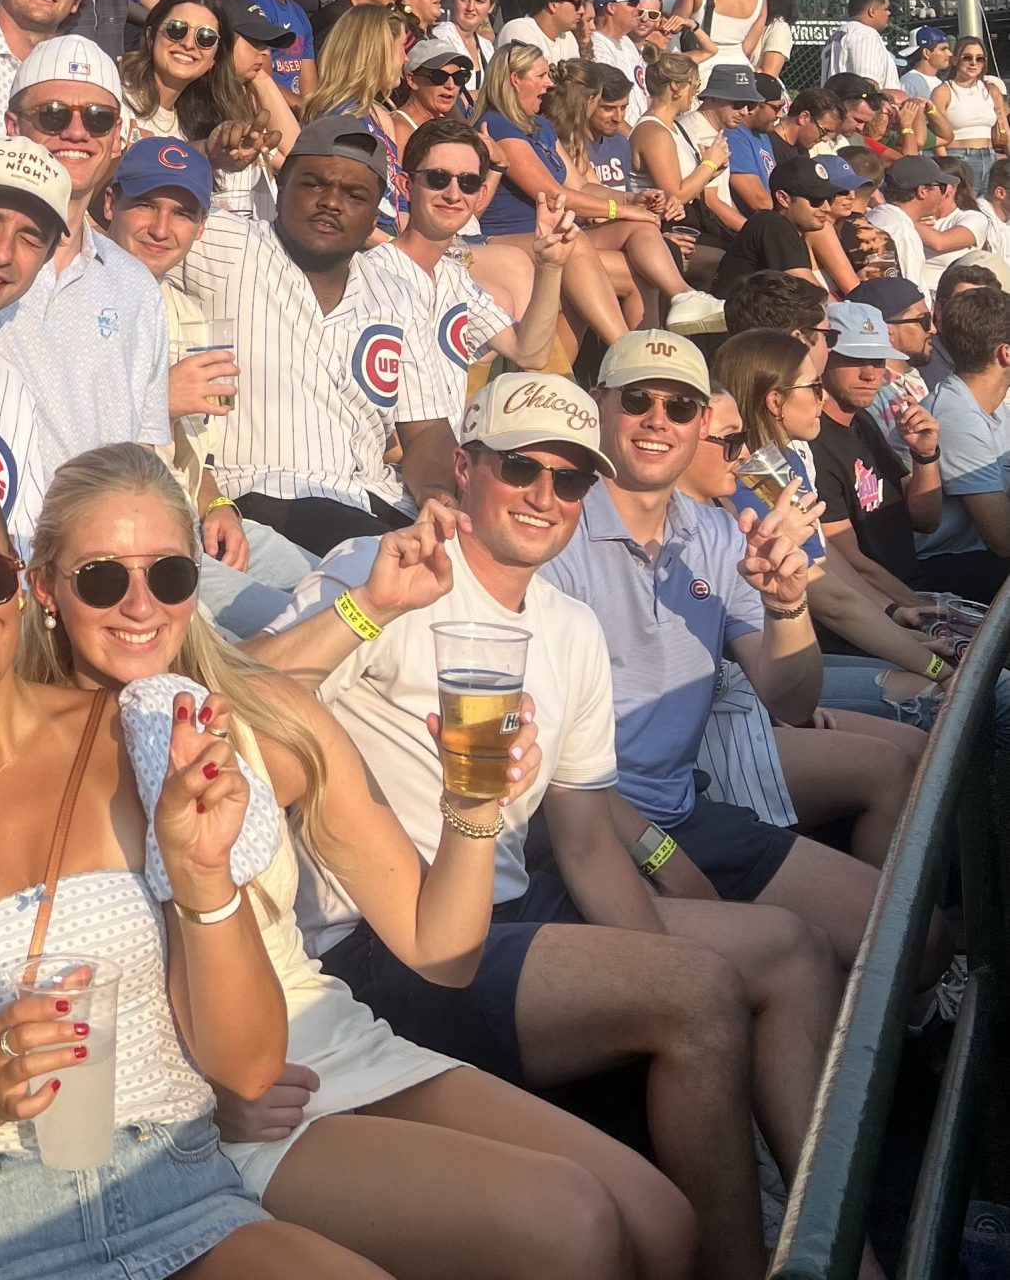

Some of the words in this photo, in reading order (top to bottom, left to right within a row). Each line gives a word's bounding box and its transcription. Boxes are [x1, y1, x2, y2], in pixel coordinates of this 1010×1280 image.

[276, 60, 302, 72] BASEB
[157, 144, 188, 170] C
[589, 157, 625, 182] UBS
[503, 381, 598, 431] Chicago
